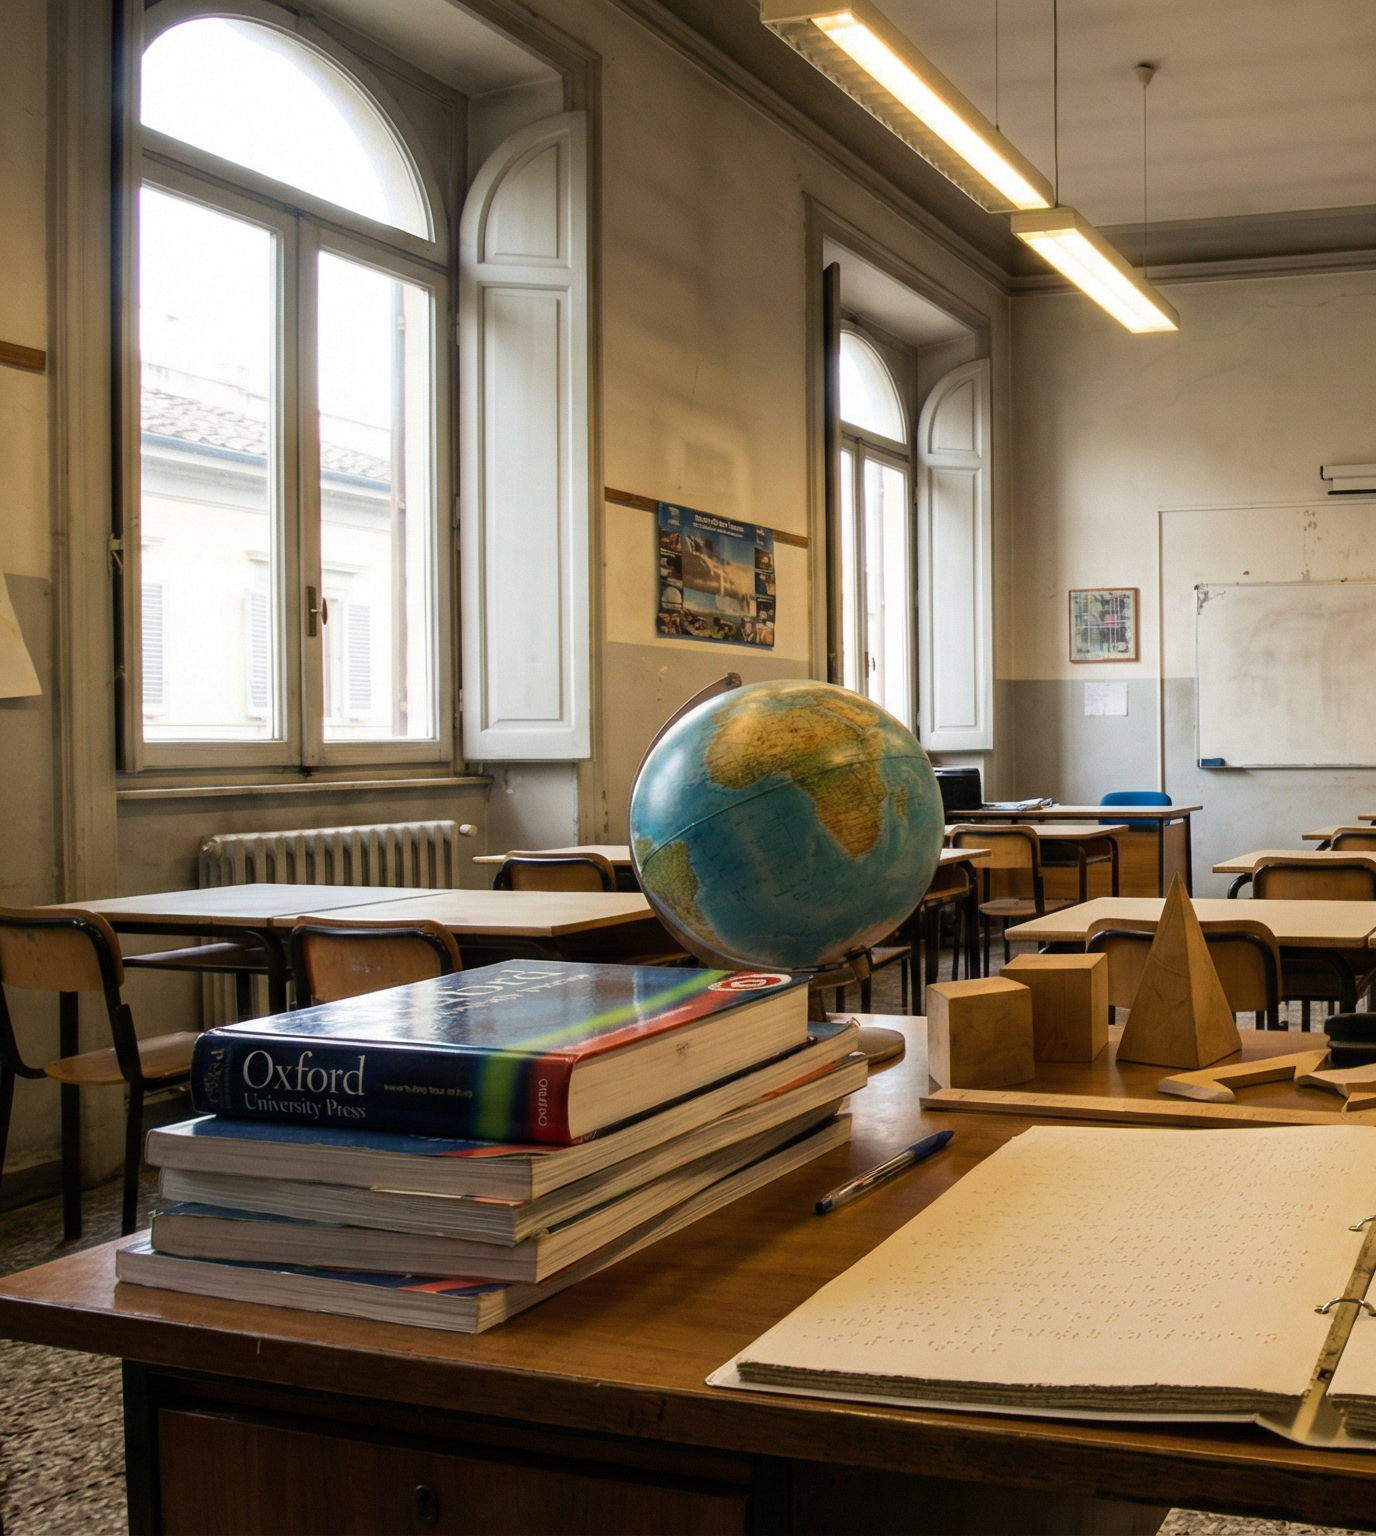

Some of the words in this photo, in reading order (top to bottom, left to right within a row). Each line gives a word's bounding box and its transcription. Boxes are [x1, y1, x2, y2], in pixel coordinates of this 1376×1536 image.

[242, 1050, 365, 1096] Oxford
[244, 1092, 320, 1119] University
[326, 1098, 366, 1119] Press
